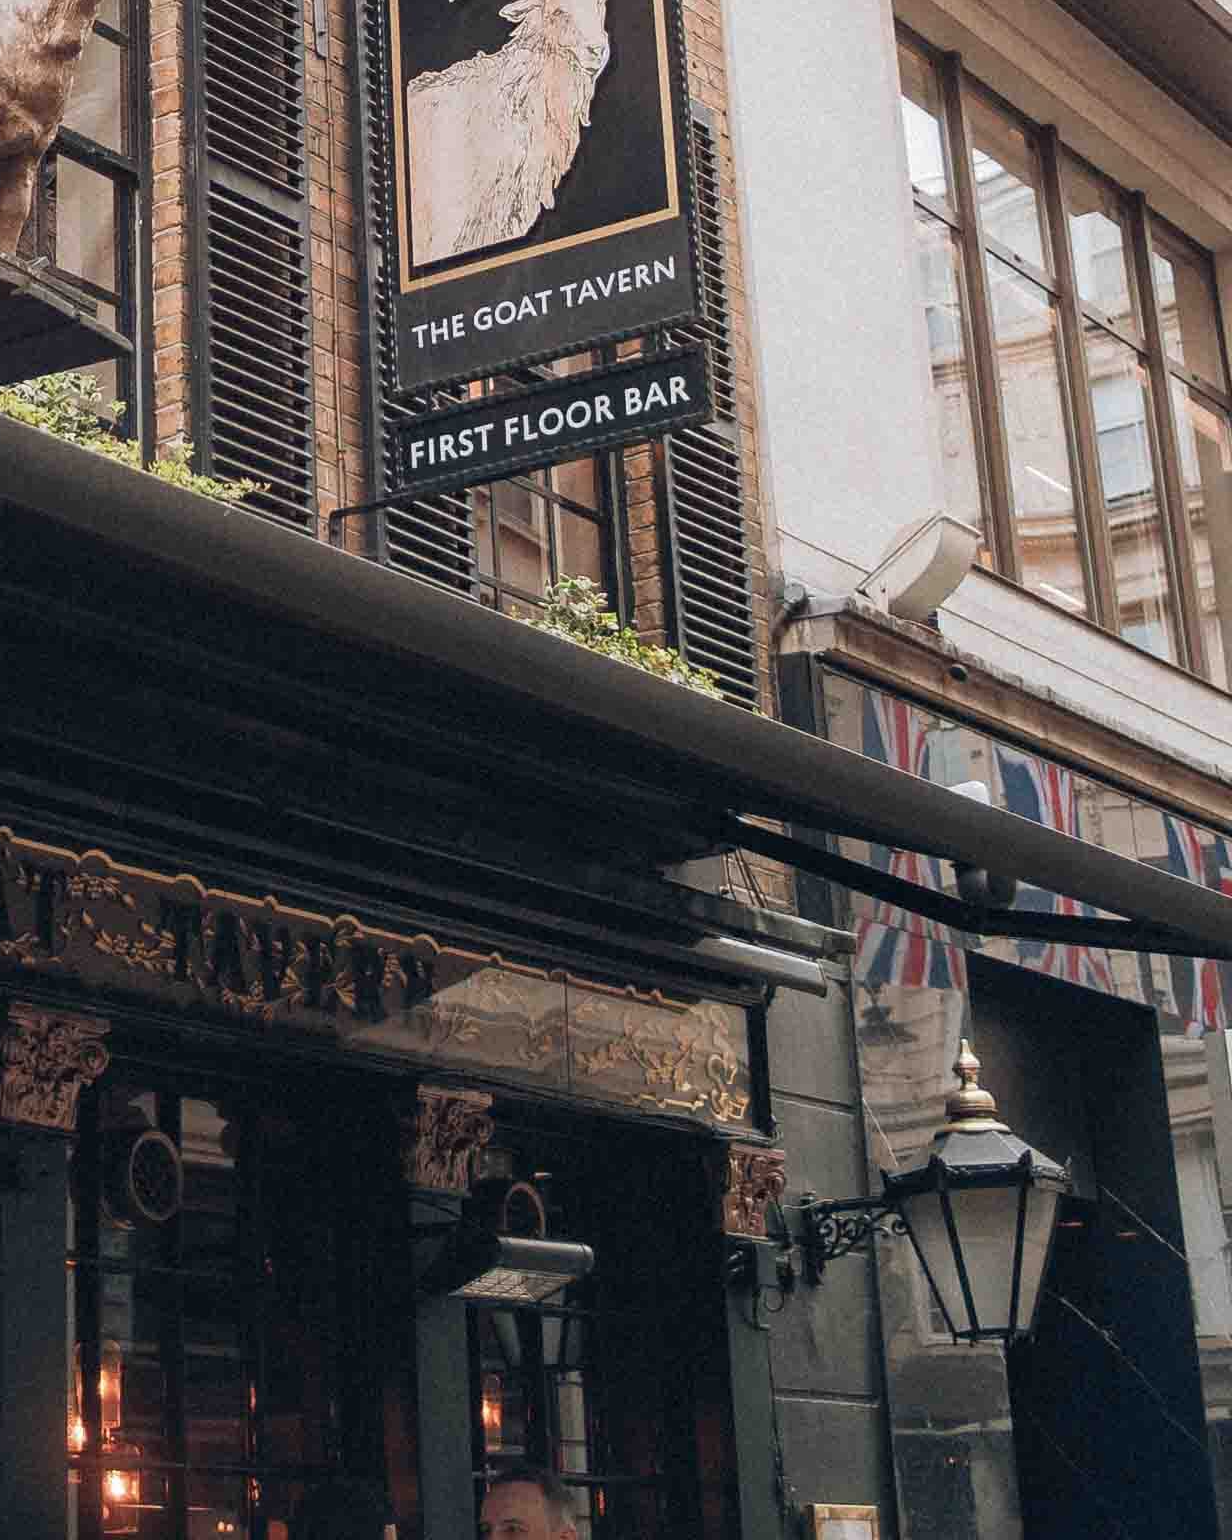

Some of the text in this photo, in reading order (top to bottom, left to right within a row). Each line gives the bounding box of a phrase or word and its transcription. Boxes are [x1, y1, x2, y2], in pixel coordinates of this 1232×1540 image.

[411, 255, 676, 349] THE GOAT TAVERN
[410, 375, 691, 469] FIRST FLOOR BAR
